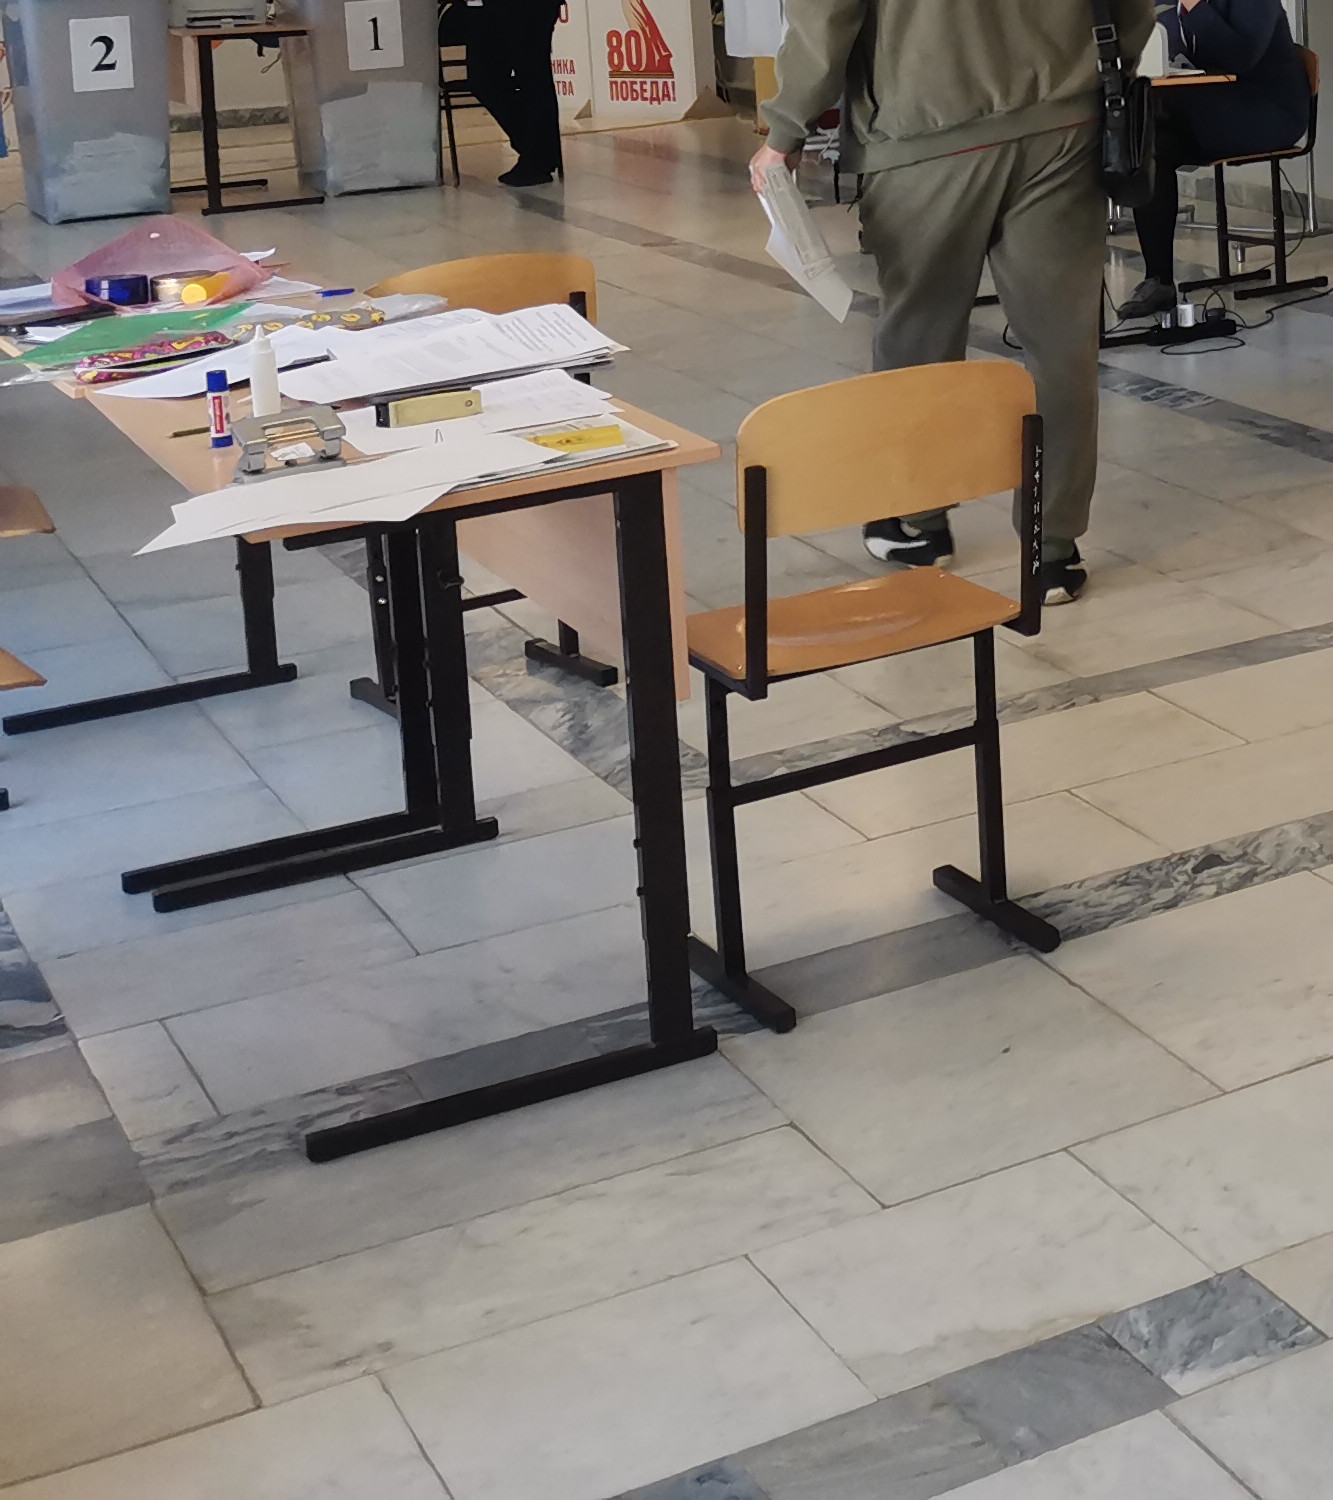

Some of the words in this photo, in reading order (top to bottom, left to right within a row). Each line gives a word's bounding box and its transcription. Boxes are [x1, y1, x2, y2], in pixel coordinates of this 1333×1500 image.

[367, 16, 384, 51] 1
[606, 29, 647, 72] 80
[90, 35, 117, 72] 2
[609, 80, 676, 105] ПОБЕДА!
